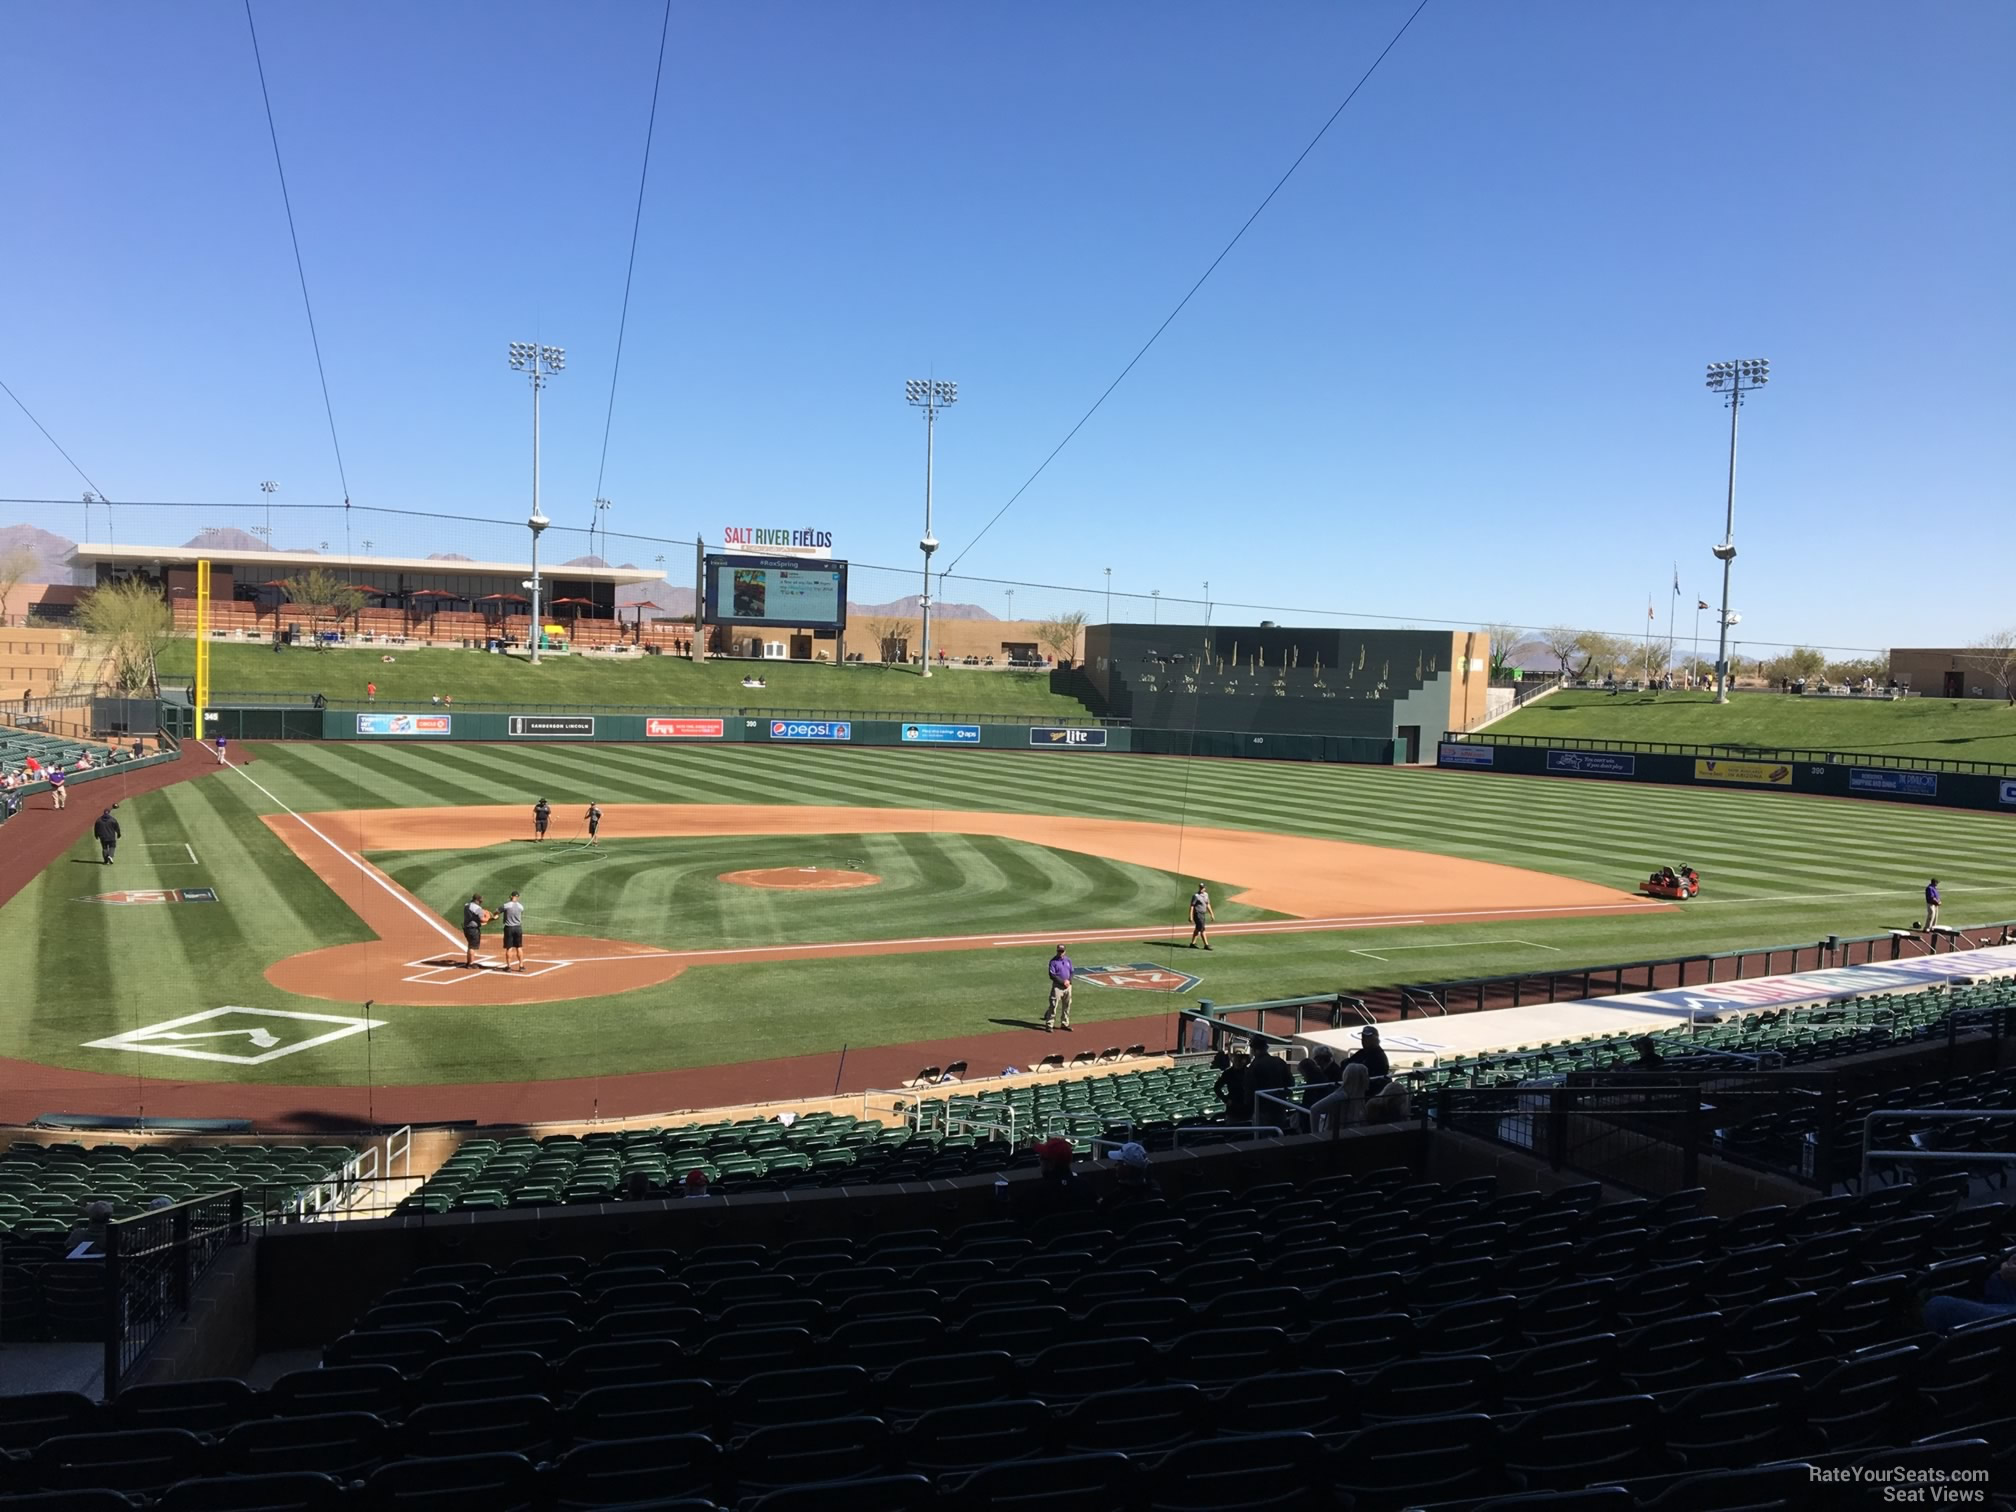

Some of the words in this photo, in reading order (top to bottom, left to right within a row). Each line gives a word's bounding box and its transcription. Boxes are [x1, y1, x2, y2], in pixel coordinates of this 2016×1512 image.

[724, 527, 752, 544] SALT
[755, 528, 790, 546] RIVER
[792, 530, 833, 548] FIELDS
[759, 560, 799, 569] #RoxSpring
[204, 712, 219, 721] 345
[787, 723, 829, 737] pepsi
[964, 731, 977, 739] aps
[1065, 730, 1088, 745] Lite
[1811, 767, 1825, 775] 390
[1109, 972, 1181, 985] AZ
